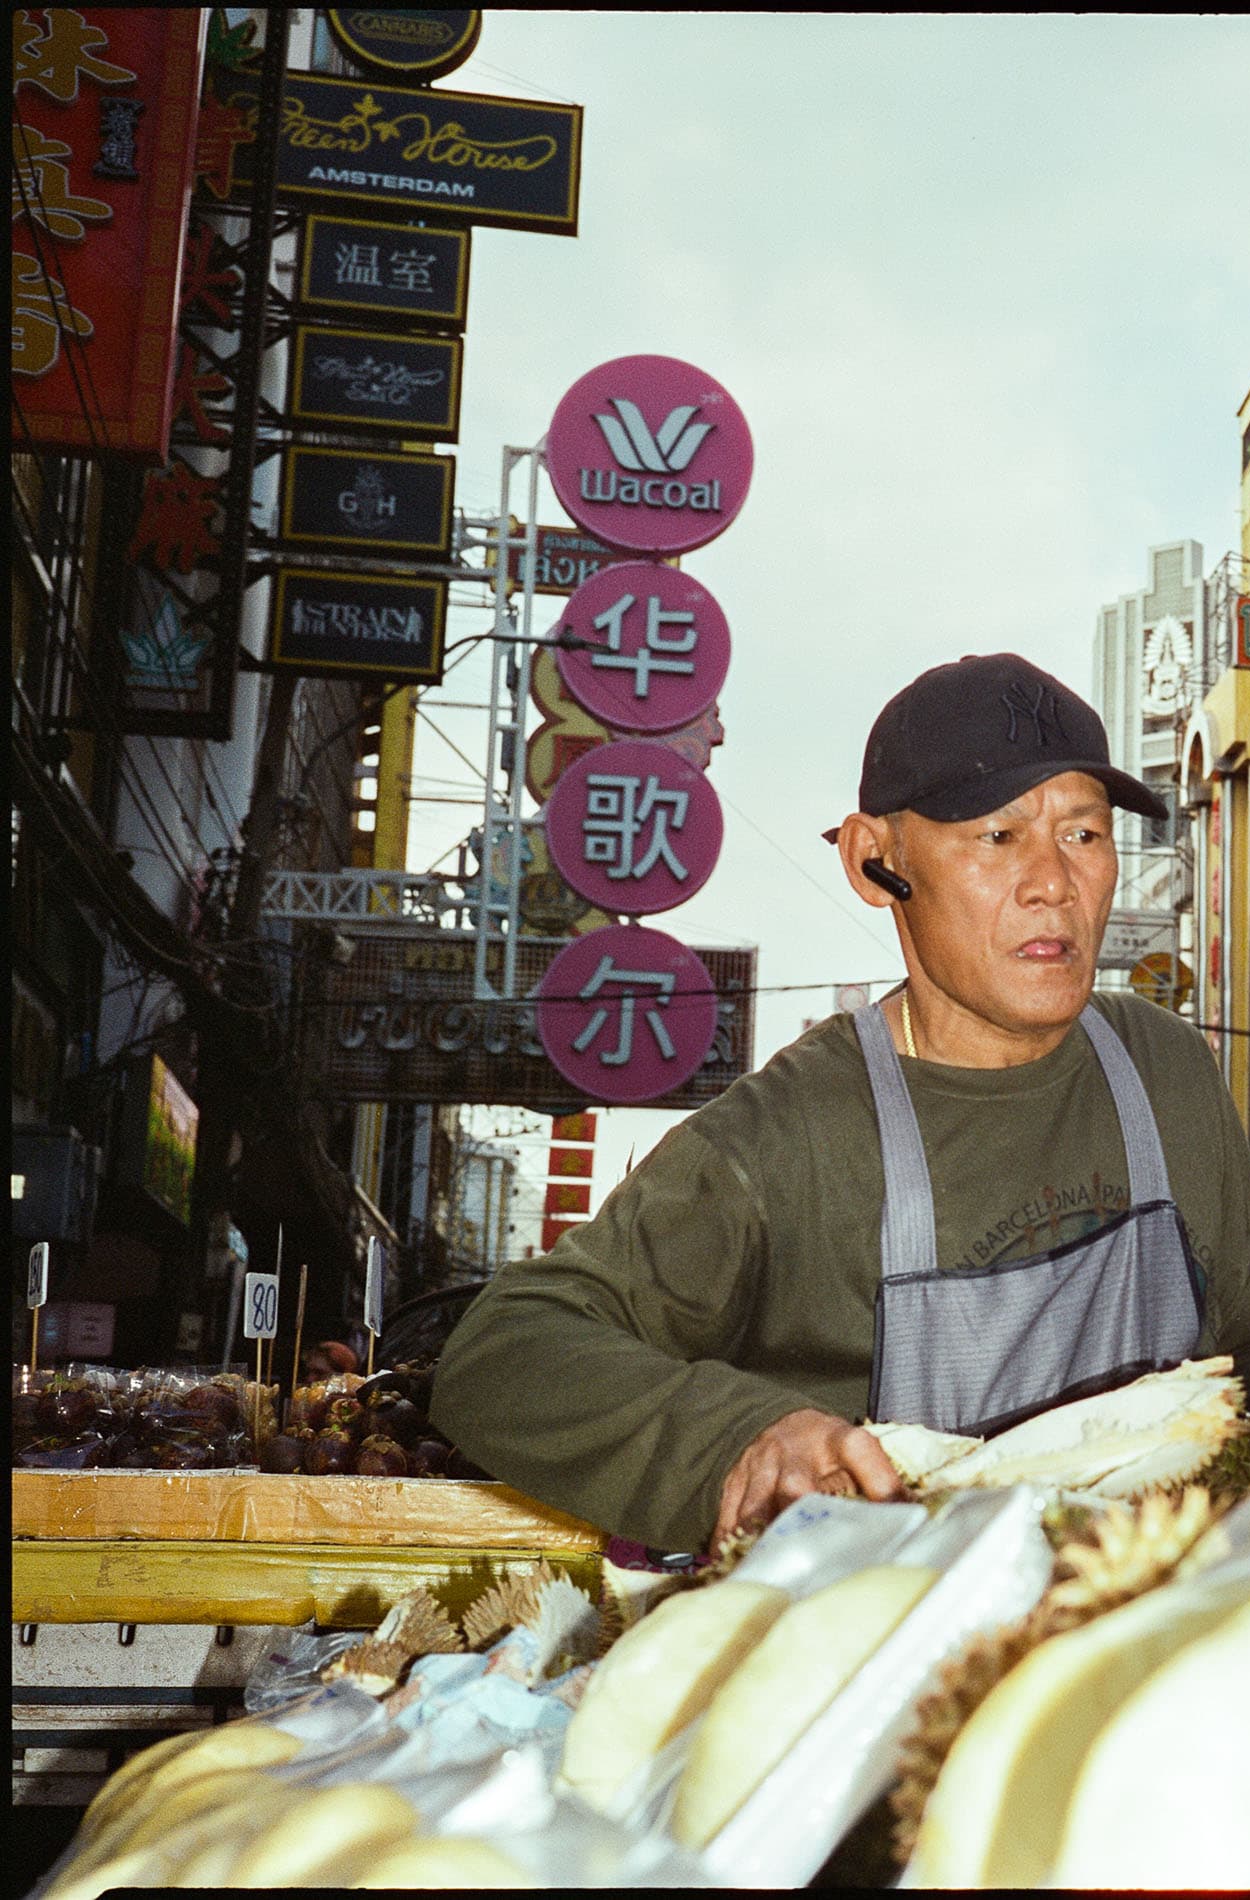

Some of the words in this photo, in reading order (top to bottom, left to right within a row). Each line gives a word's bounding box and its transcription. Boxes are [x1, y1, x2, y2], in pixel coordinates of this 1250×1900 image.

[394, 113, 558, 171] House
[308, 165, 475, 198] AMSTERDAM
[335, 243, 437, 293] 温室
[580, 467, 722, 511] Wacoal
[971, 1184, 1092, 1260] BARCELONA
[253, 1282, 277, 1332] 80
